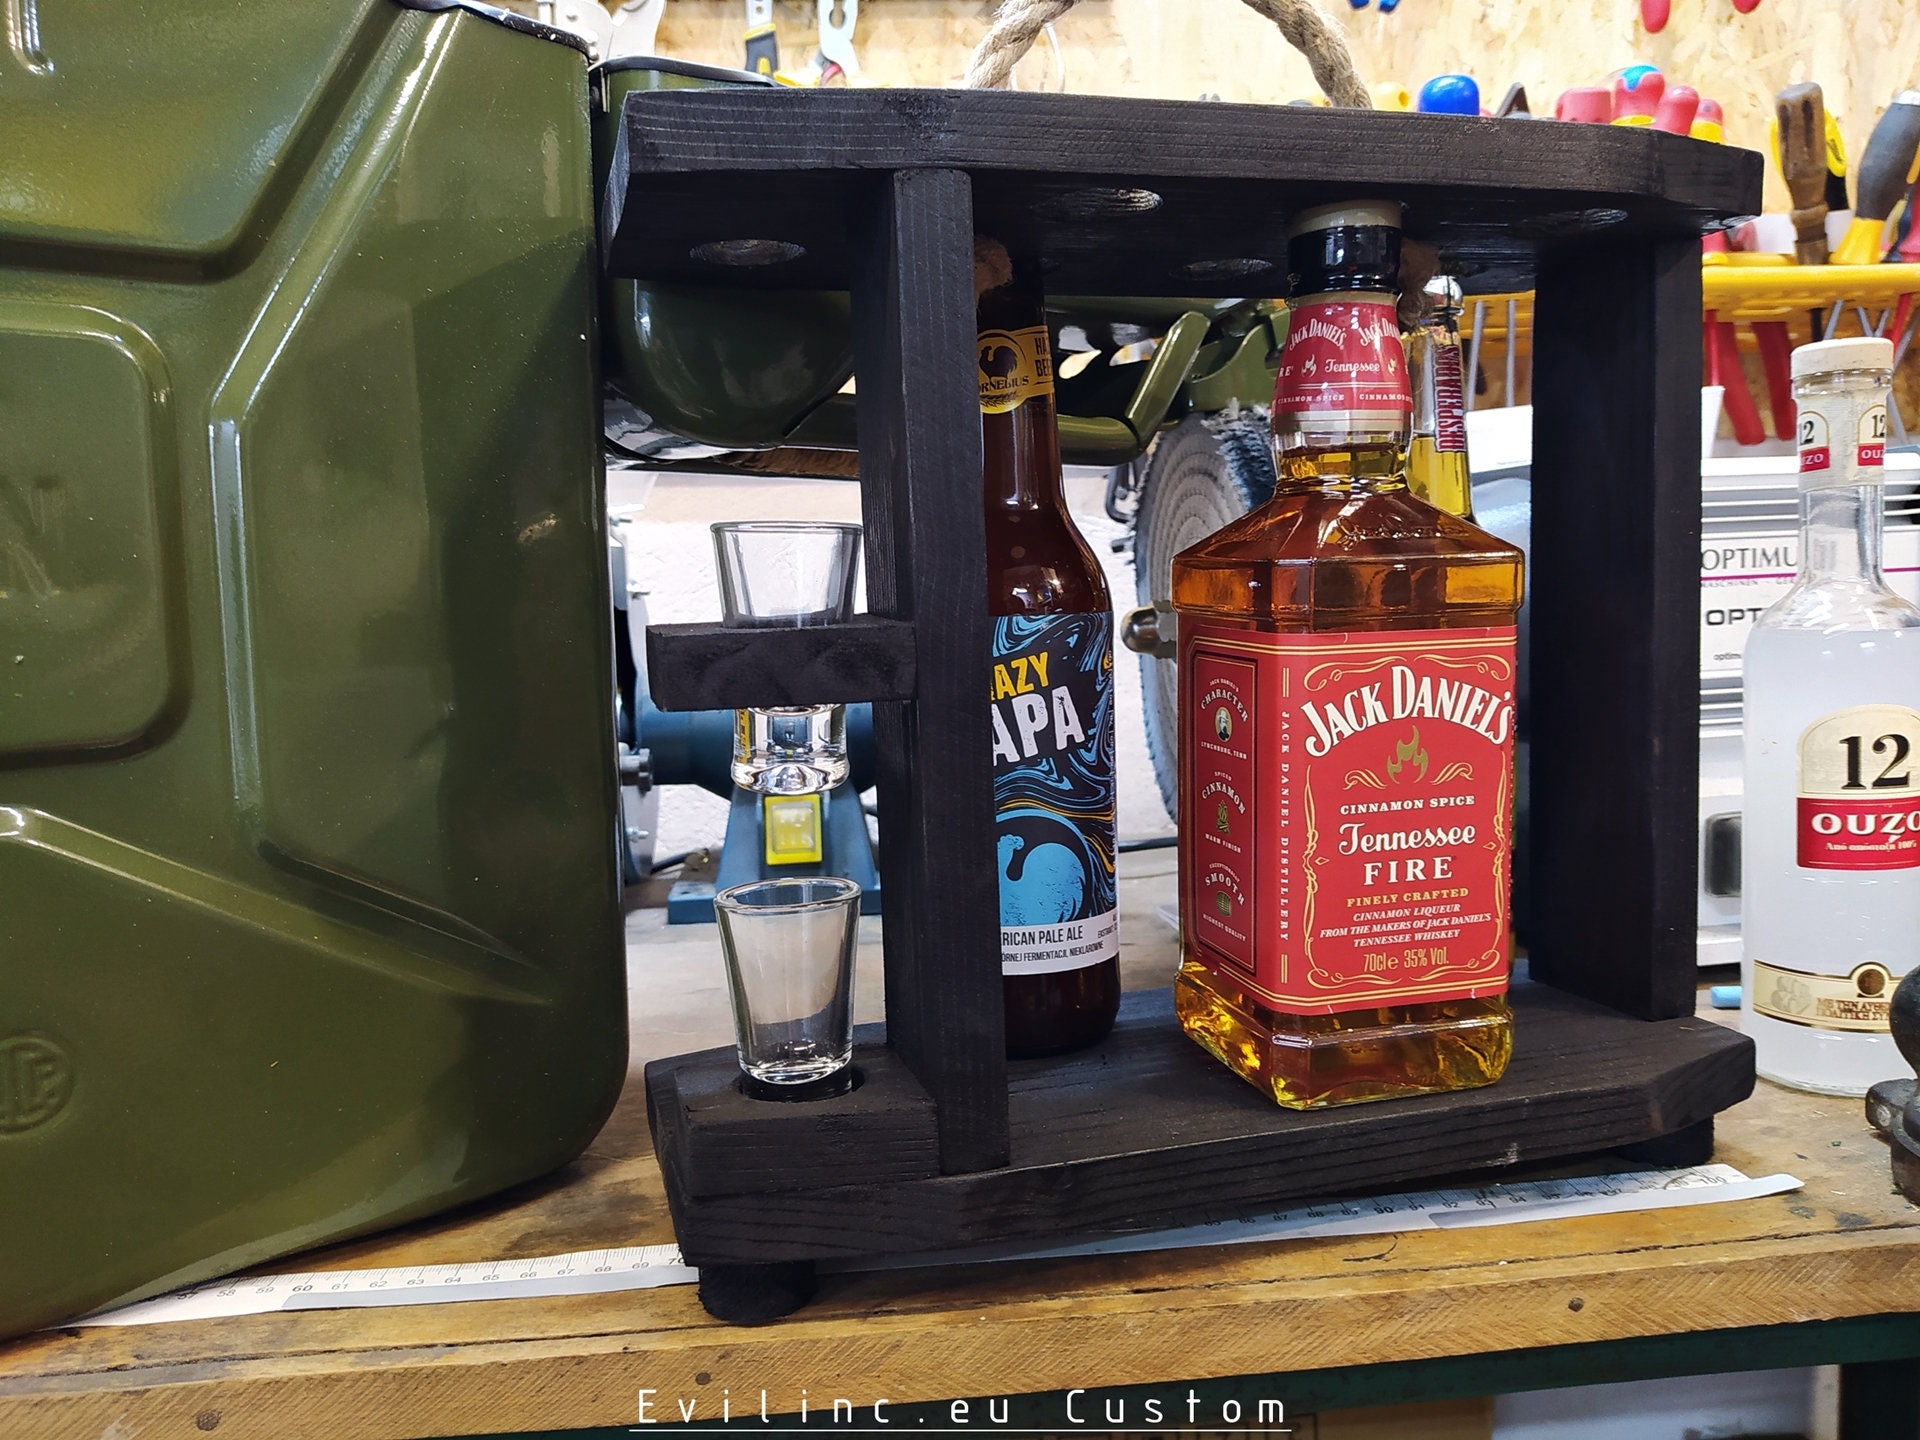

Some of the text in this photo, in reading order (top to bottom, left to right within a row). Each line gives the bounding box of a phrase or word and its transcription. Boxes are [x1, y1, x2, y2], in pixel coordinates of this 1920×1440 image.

[1290, 325, 1307, 350] JACK
[1325, 358, 1380, 373] Tennessee
[980, 376, 1029, 393] RNELIUS
[1800, 420, 1814, 446] 2
[1801, 453, 1824, 465] ZO
[991, 651, 1049, 701] AZY
[1201, 688, 1248, 722] CHARACTER
[1300, 665, 1513, 757] JACK DANIEL'S
[1839, 734, 1910, 790] 12
[1202, 781, 1246, 815] CINNAMON
[1340, 795, 1475, 815] CINNAMON SPICE
[1280, 711, 1290, 940] JACK DANIEL DISTILLERY
[1811, 811, 1920, 835] OUZO
[1338, 822, 1476, 855] Tennessee
[1363, 856, 1453, 886] FIRE
[1205, 872, 1245, 905] SMOOTH
[1346, 888, 1469, 907] FINELY CRAFTED
[1353, 903, 1461, 922] CINNAMON LIQUEUR
[1001, 925, 1083, 946] RICAN PALE ALE
[1319, 913, 1492, 938] FROM THE MAKERS OF JACK DANIEL'S
[1353, 929, 1461, 948] TENNESSEE WHISKEY
[1404, 949, 1428, 968] 35%
[1430, 947, 1449, 966] Vol.
[1374, 1206, 1394, 1214] 90
[217, 1289, 236, 1297] 58
